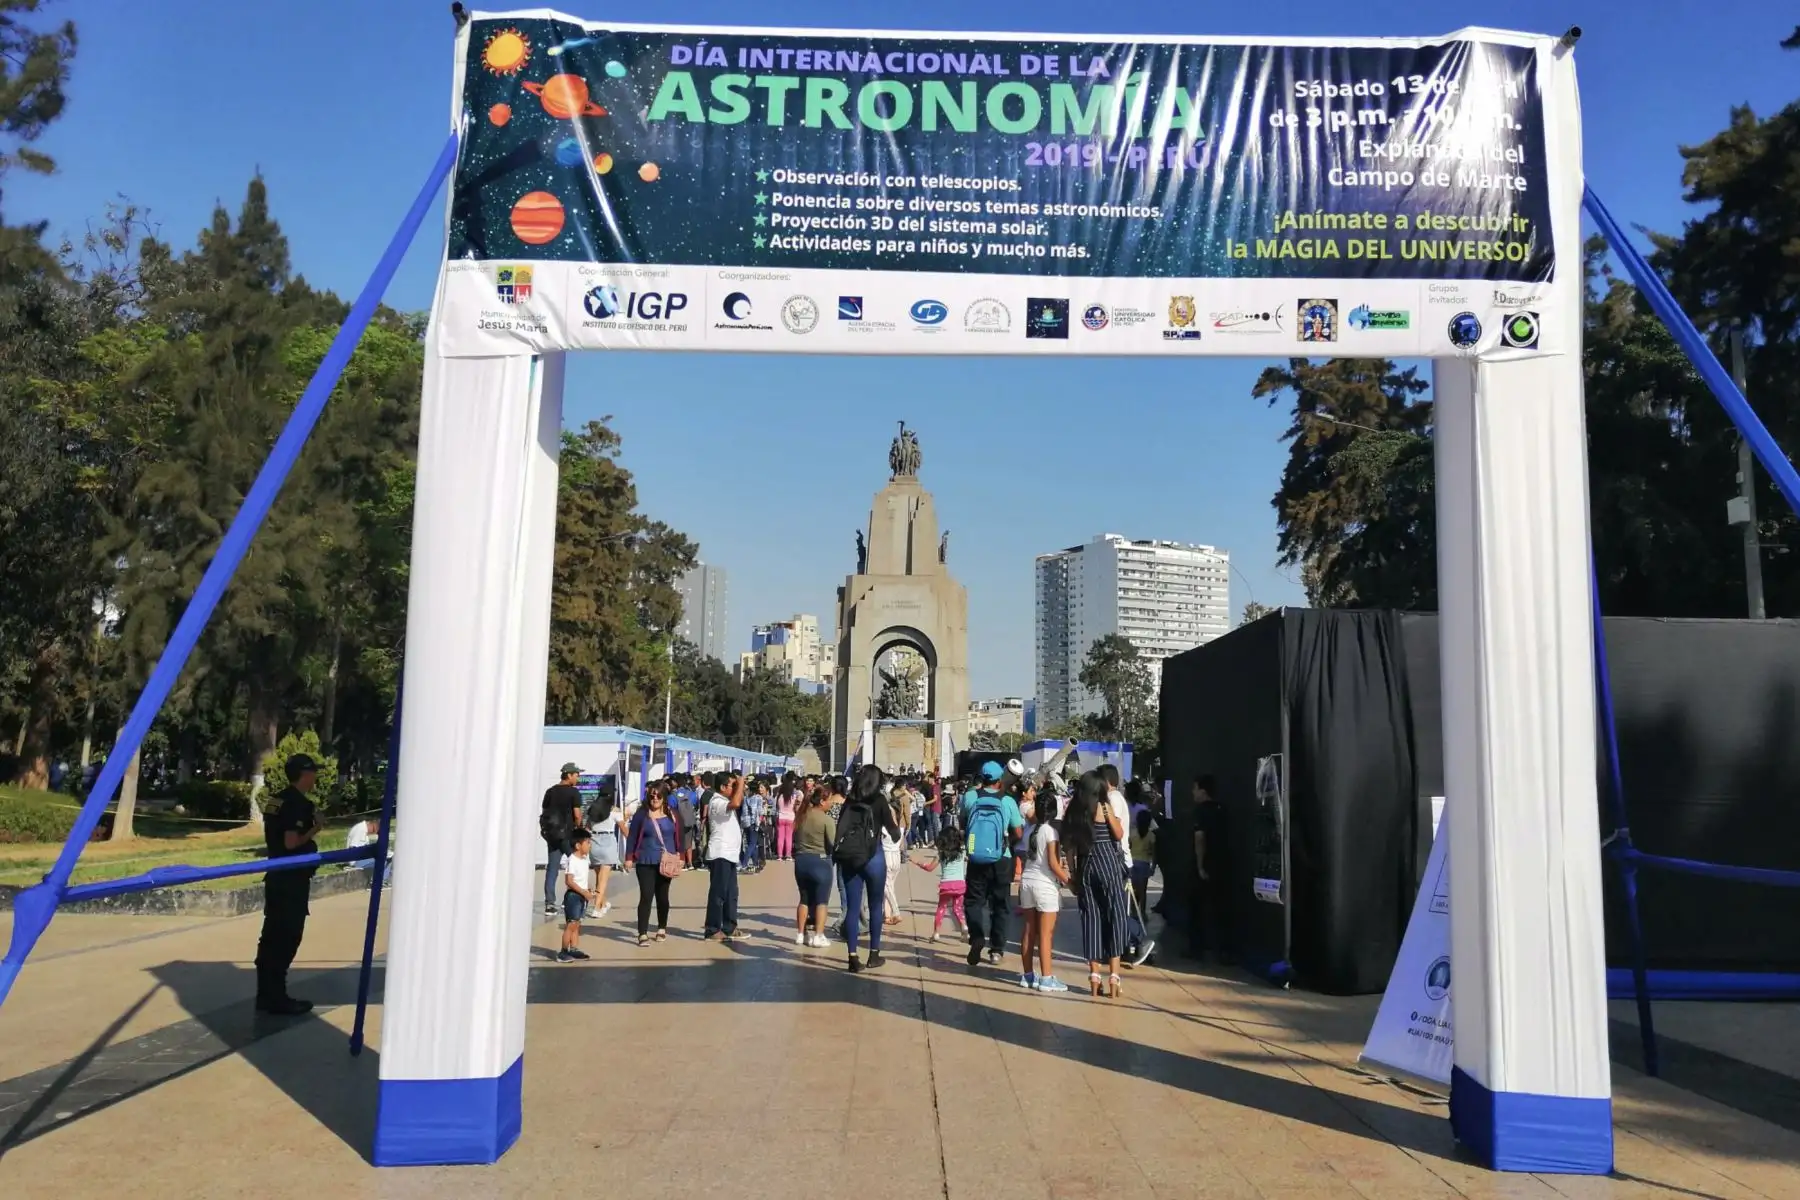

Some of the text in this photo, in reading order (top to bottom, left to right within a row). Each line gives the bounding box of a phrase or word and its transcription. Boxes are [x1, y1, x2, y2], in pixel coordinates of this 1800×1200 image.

[671, 41, 1110, 77] DÍA INTERNACIONAL DE LA
[1295, 79, 1384, 98] Sábado
[1391, 75, 1425, 94] 13
[1432, 76, 1460, 95] de
[647, 70, 1205, 138] ASTRONOMÍA
[1270, 109, 1299, 127] de
[1306, 108, 1322, 127] 3
[1331, 108, 1395, 132] p.m.
[1024, 142, 1100, 167] 2019
[1129, 140, 1210, 169] PRÚ
[1491, 144, 1525, 163] del
[772, 169, 1022, 193] Observación con telescopios.
[1328, 168, 1528, 191] Campo de Marte
[772, 192, 1164, 218] Ponencia sobre diversos temas astronómicos.
[771, 213, 1049, 236] Proyección 3D del sistema solar.
[1273, 208, 1530, 234] ¡Anímate a descubrir
[769, 234, 1091, 258] Actividades para niños y mucho más.
[1227, 238, 1530, 262] la MAGIA DEL UNIVERSO!
[578, 265, 633, 278] Coodinación
[1428, 283, 1459, 294] Grupos
[626, 292, 688, 320] IGP
[477, 318, 513, 330] Jesús
[582, 320, 617, 329] INSTITUTO
[654, 323, 668, 331] DEL
